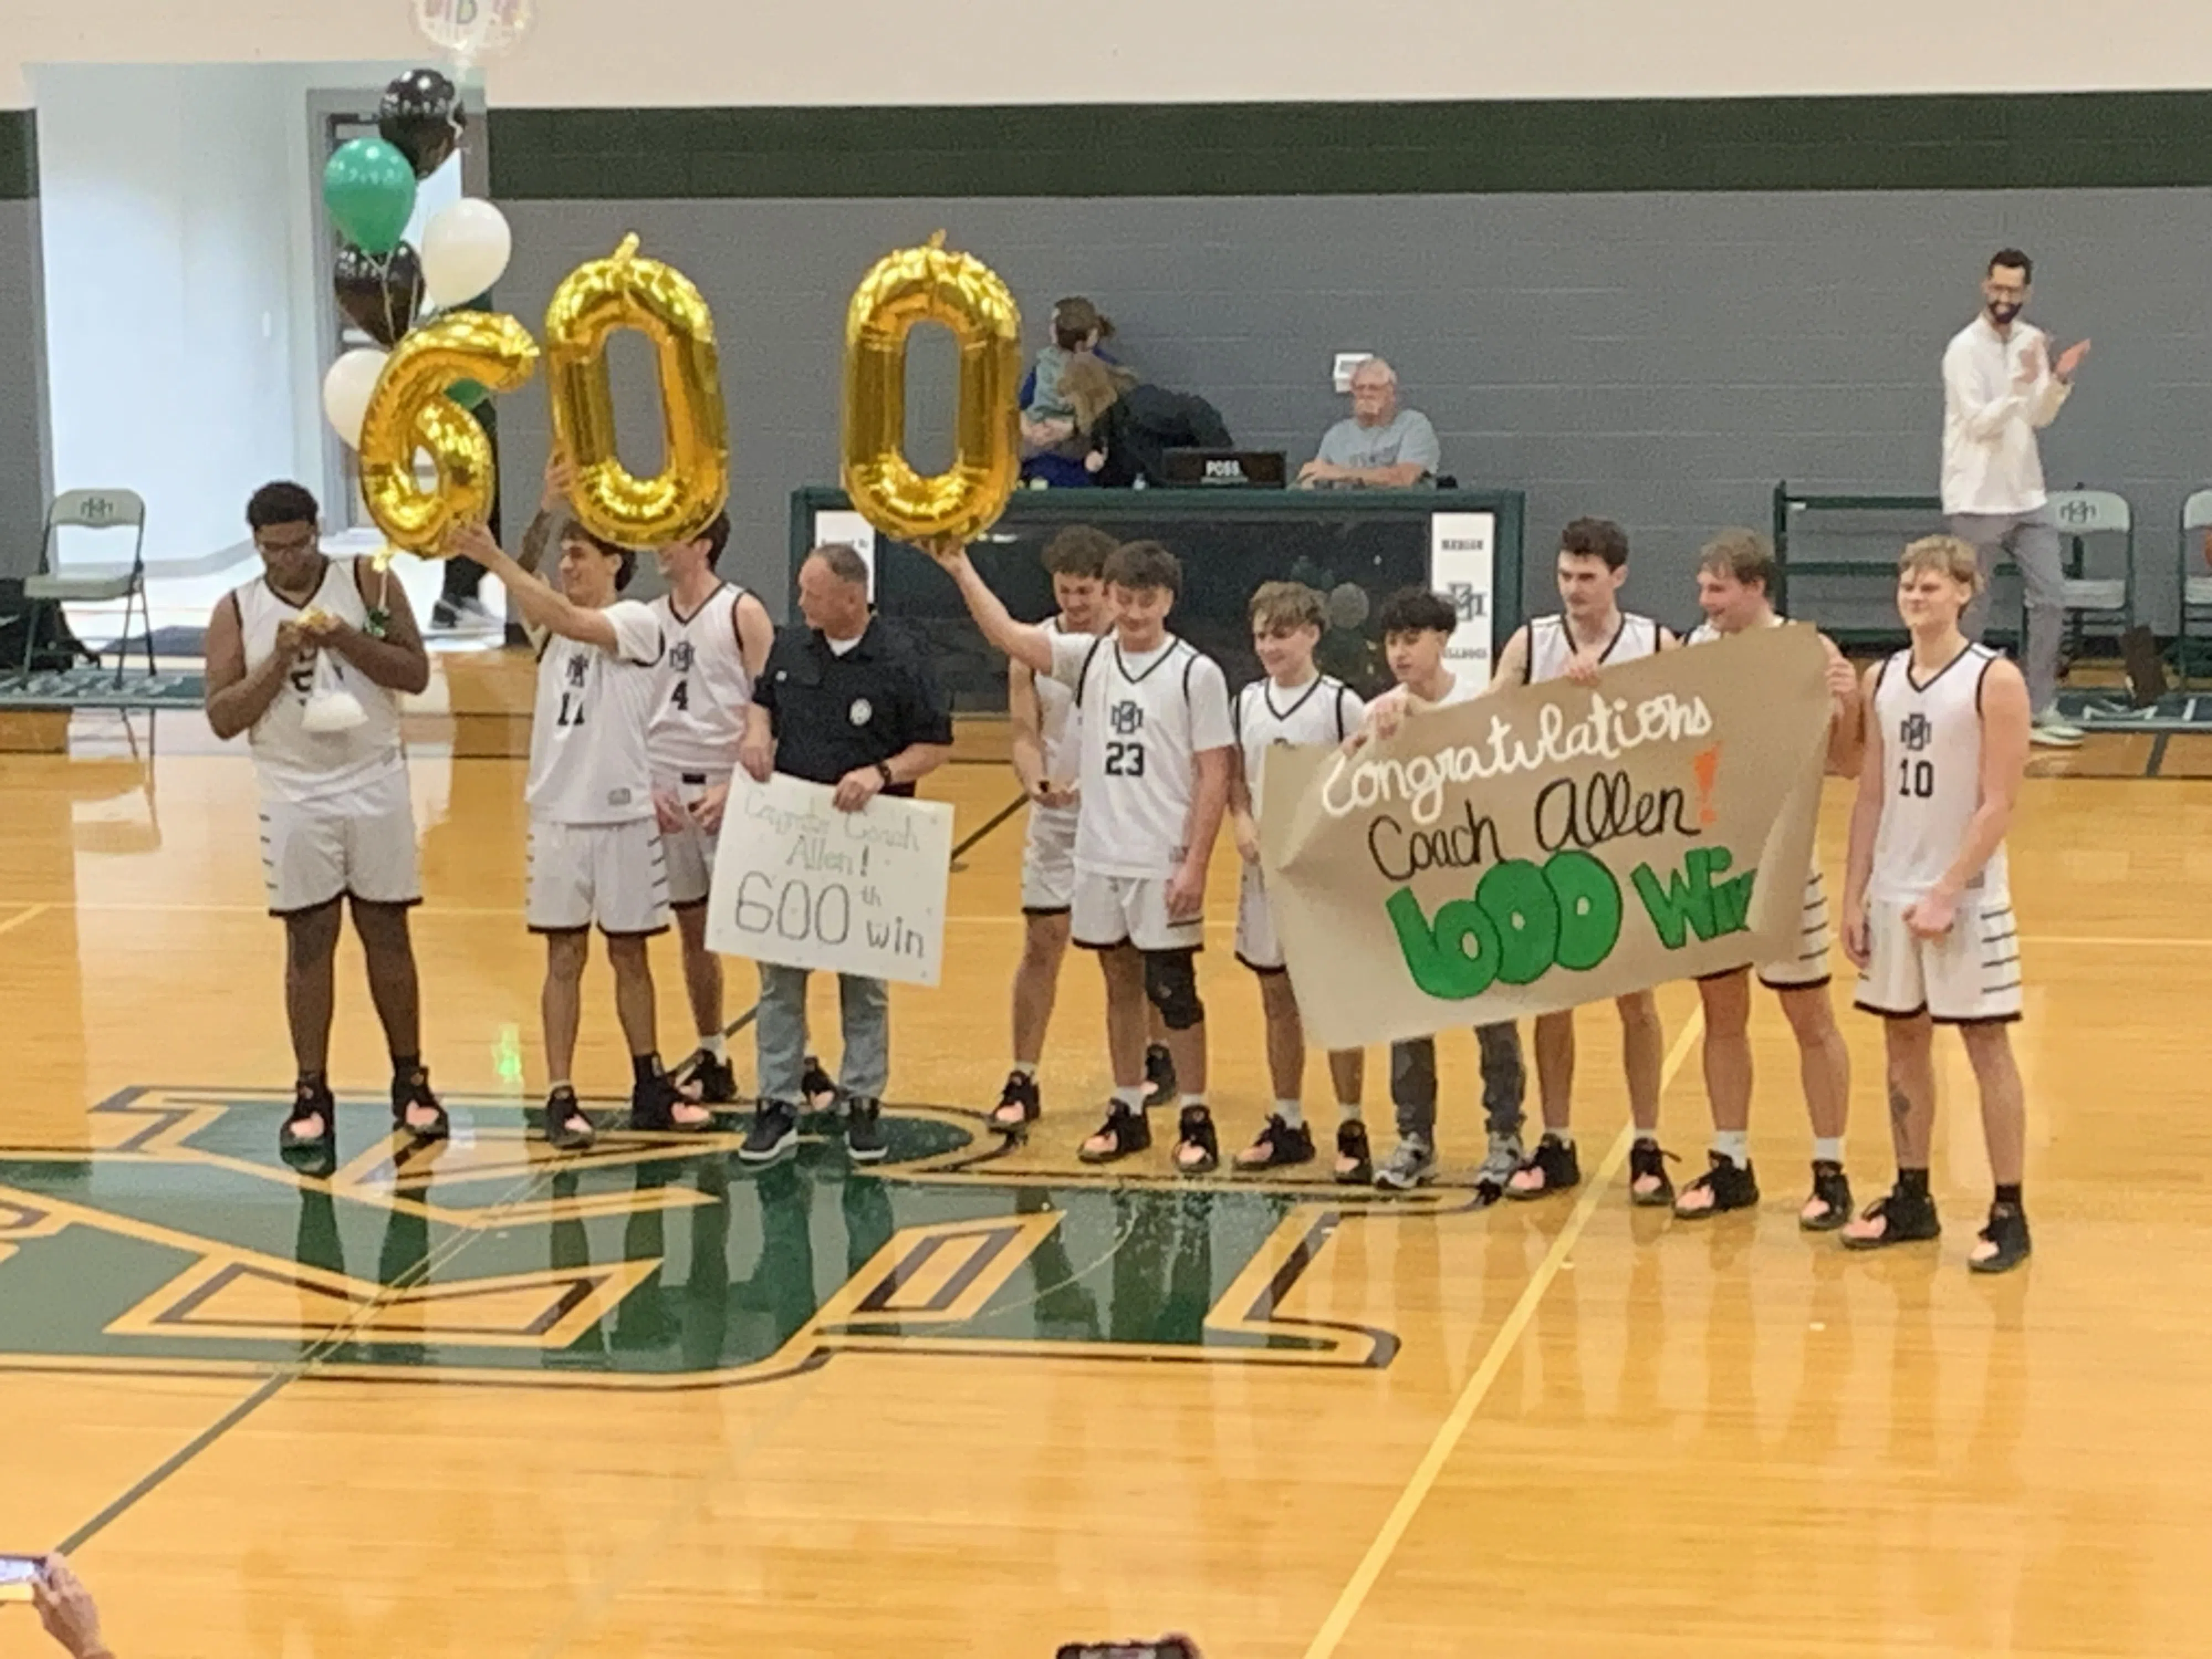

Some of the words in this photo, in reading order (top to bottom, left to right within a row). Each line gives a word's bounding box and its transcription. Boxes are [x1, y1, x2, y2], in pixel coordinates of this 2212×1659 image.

[557, 692, 585, 726] 11
[671, 679, 688, 711] 4
[1105, 742, 1145, 776] 23
[1899, 758, 1934, 798] 10
[1368, 799, 1507, 882] Coach
[867, 916, 924, 958] win
[1385, 849, 1624, 1000] 600
